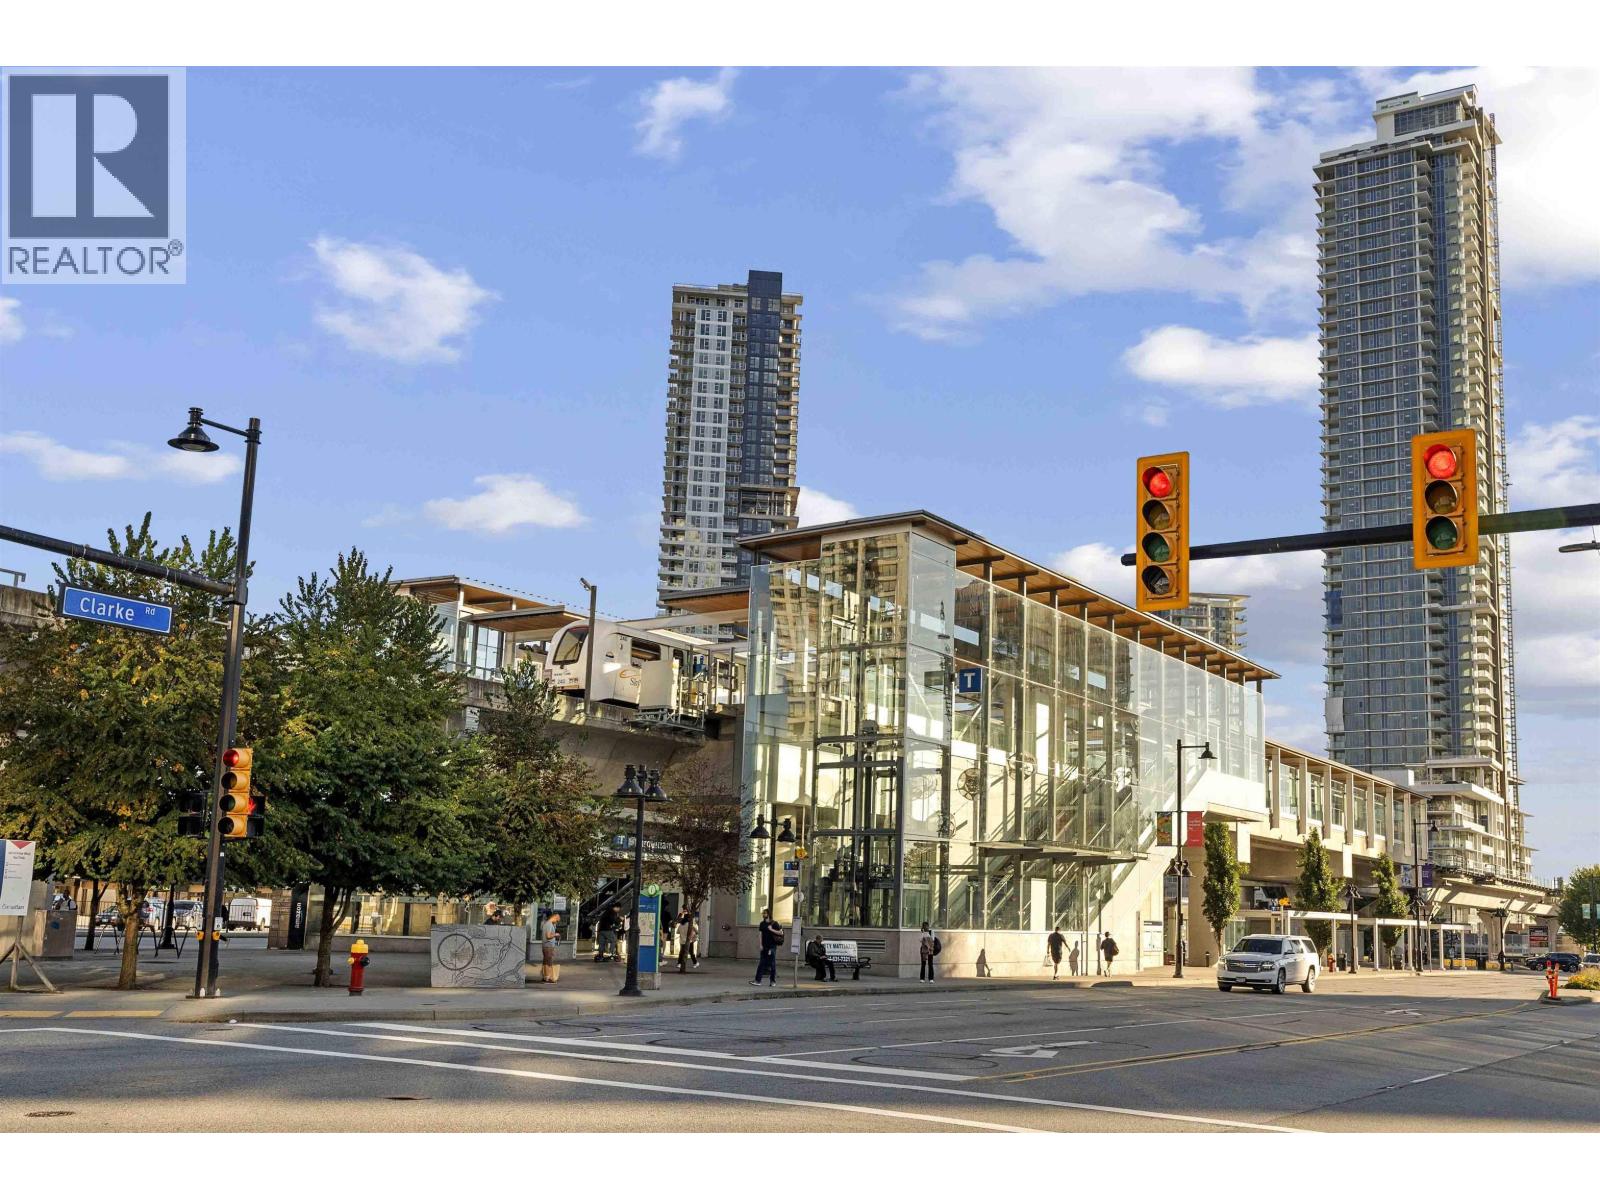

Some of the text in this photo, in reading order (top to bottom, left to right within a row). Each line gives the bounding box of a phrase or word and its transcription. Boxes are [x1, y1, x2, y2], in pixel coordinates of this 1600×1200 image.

[80, 597, 156, 621] Clarke Rd
[964, 672, 976, 688] T
[294, 902, 303, 929] amazon
